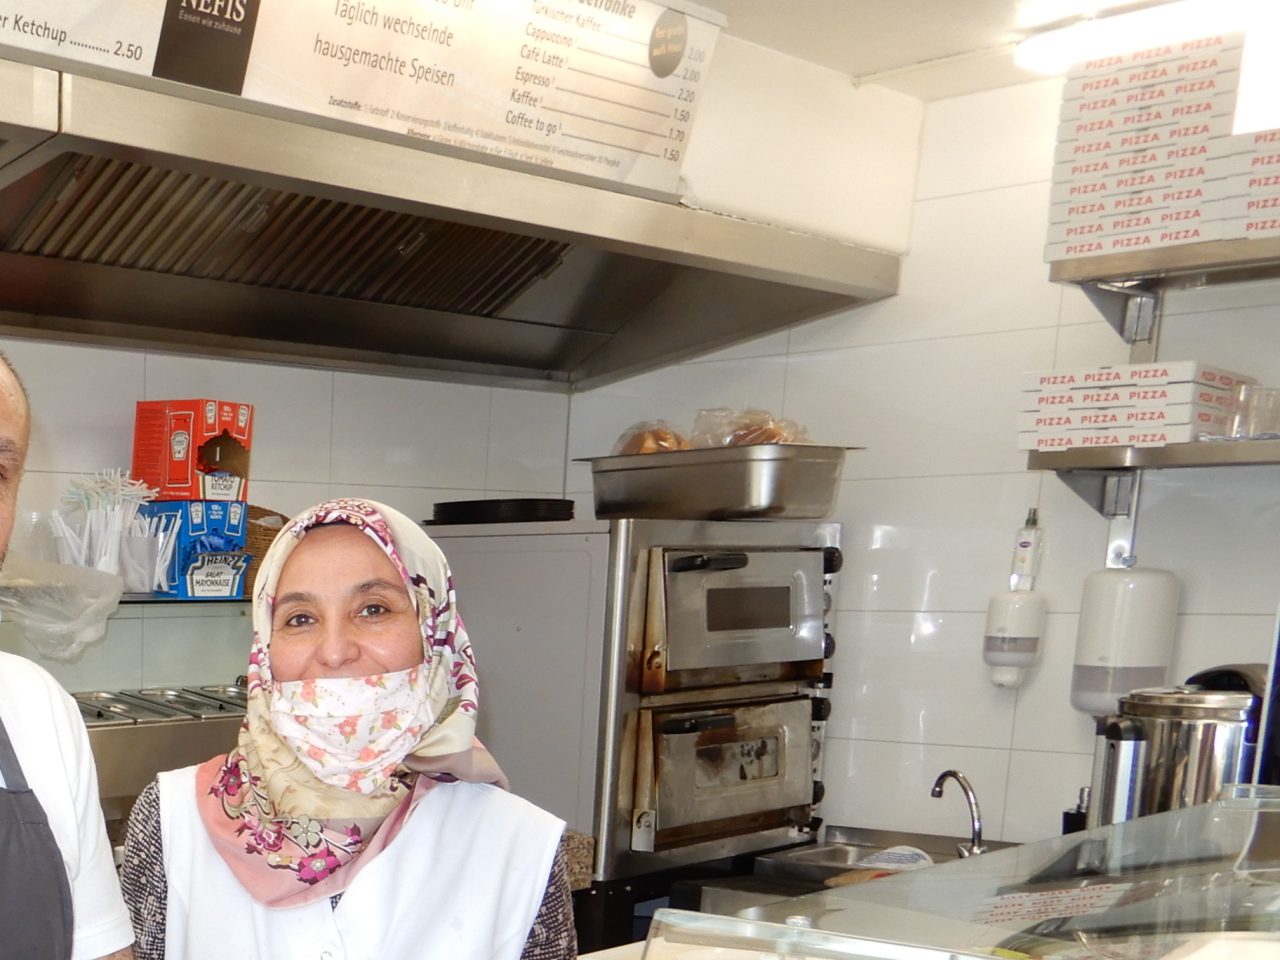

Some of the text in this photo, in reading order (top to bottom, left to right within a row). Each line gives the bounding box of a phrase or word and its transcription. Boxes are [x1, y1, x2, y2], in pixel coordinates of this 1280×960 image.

[13, 13, 67, 46] Ketchup
[114, 40, 143, 61] 2.50
[334, 0, 454, 47] Täglich wechselnde
[313, 32, 456, 87] hausgemachte Speisen
[688, 47, 706, 63] 2.00
[542, 51, 563, 69] Latte
[677, 88, 695, 103] 2.20
[682, 67, 700, 83] 2.00
[1082, 58, 1219, 92] PIZZA PIZZA PIZZA
[515, 66, 690, 122] Espresso 1.50
[1078, 80, 1216, 111] PIZZA PIZZA PIZZA
[511, 88, 685, 142] Kaffee 1.70
[1075, 101, 1214, 133] PIZZA PIZZA PIZZA
[506, 110, 680, 162] Coffee to go 1.50
[1073, 123, 1211, 153] PIZZA PIZZA PIZZA
[1072, 146, 1209, 173] PIZZA PIZZA PIZZA
[1070, 166, 1206, 194] PIZZA PIZZA PIZZA
[1068, 188, 1205, 214] PIZZA PIZZA PIZZA
[1066, 209, 1201, 236] PIZZA PIZZA PIZZA
[1246, 219, 1280, 230] PIZZ
[1066, 229, 1200, 255] PIZZA PIZZA PIZZA
[1040, 369, 1168, 384] PIZZA PIZZA PIZZA
[1039, 390, 1168, 404] PIZZA PIZZA PIZZA
[1035, 411, 1167, 426] PIZZA PIZZA PIZZA
[1038, 434, 1168, 446] PIZZA PIZZA PIZZA
[207, 556, 236, 566] HEINZ
